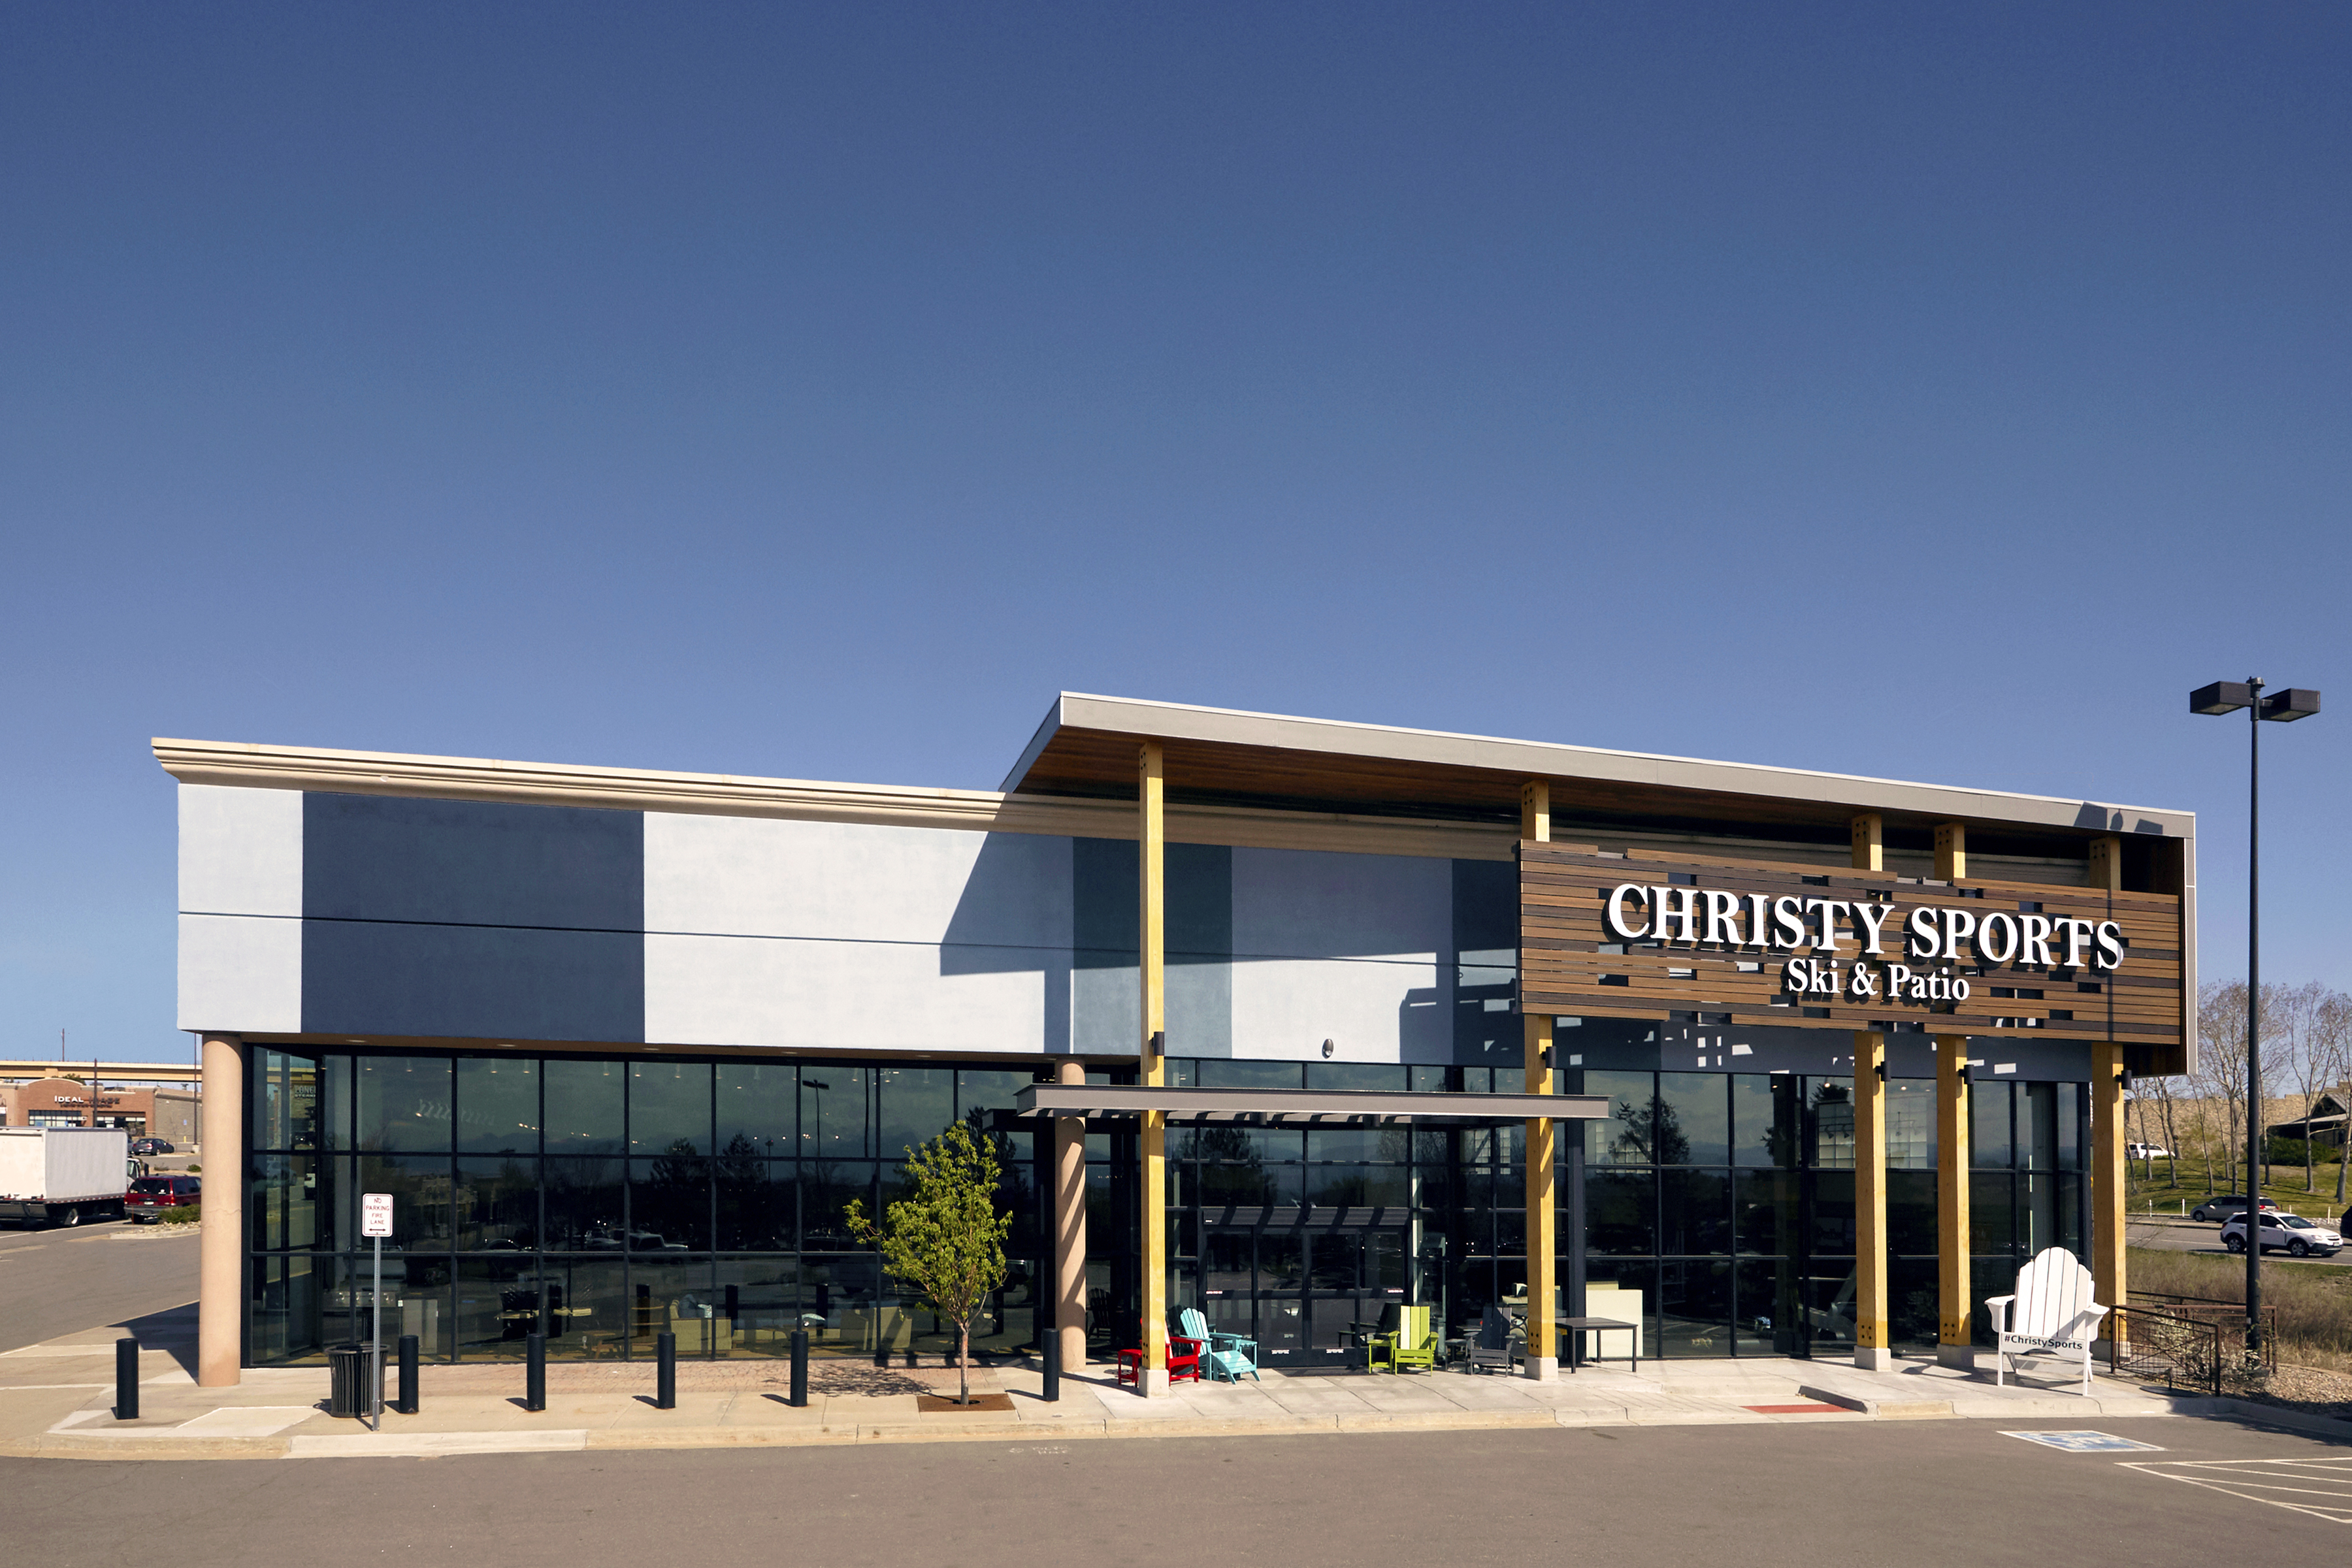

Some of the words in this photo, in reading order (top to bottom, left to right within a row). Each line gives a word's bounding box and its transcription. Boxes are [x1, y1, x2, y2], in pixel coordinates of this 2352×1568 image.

[1609, 883, 1895, 955] CHRISTY
[1910, 907, 2124, 970] SPORTS
[1788, 958, 1841, 994] Ski
[1851, 961, 1878, 996] &
[1887, 964, 1970, 1001] Patio
[294, 1085, 316, 1094] LONG
[2004, 1335, 2083, 1350] #ChristySports
